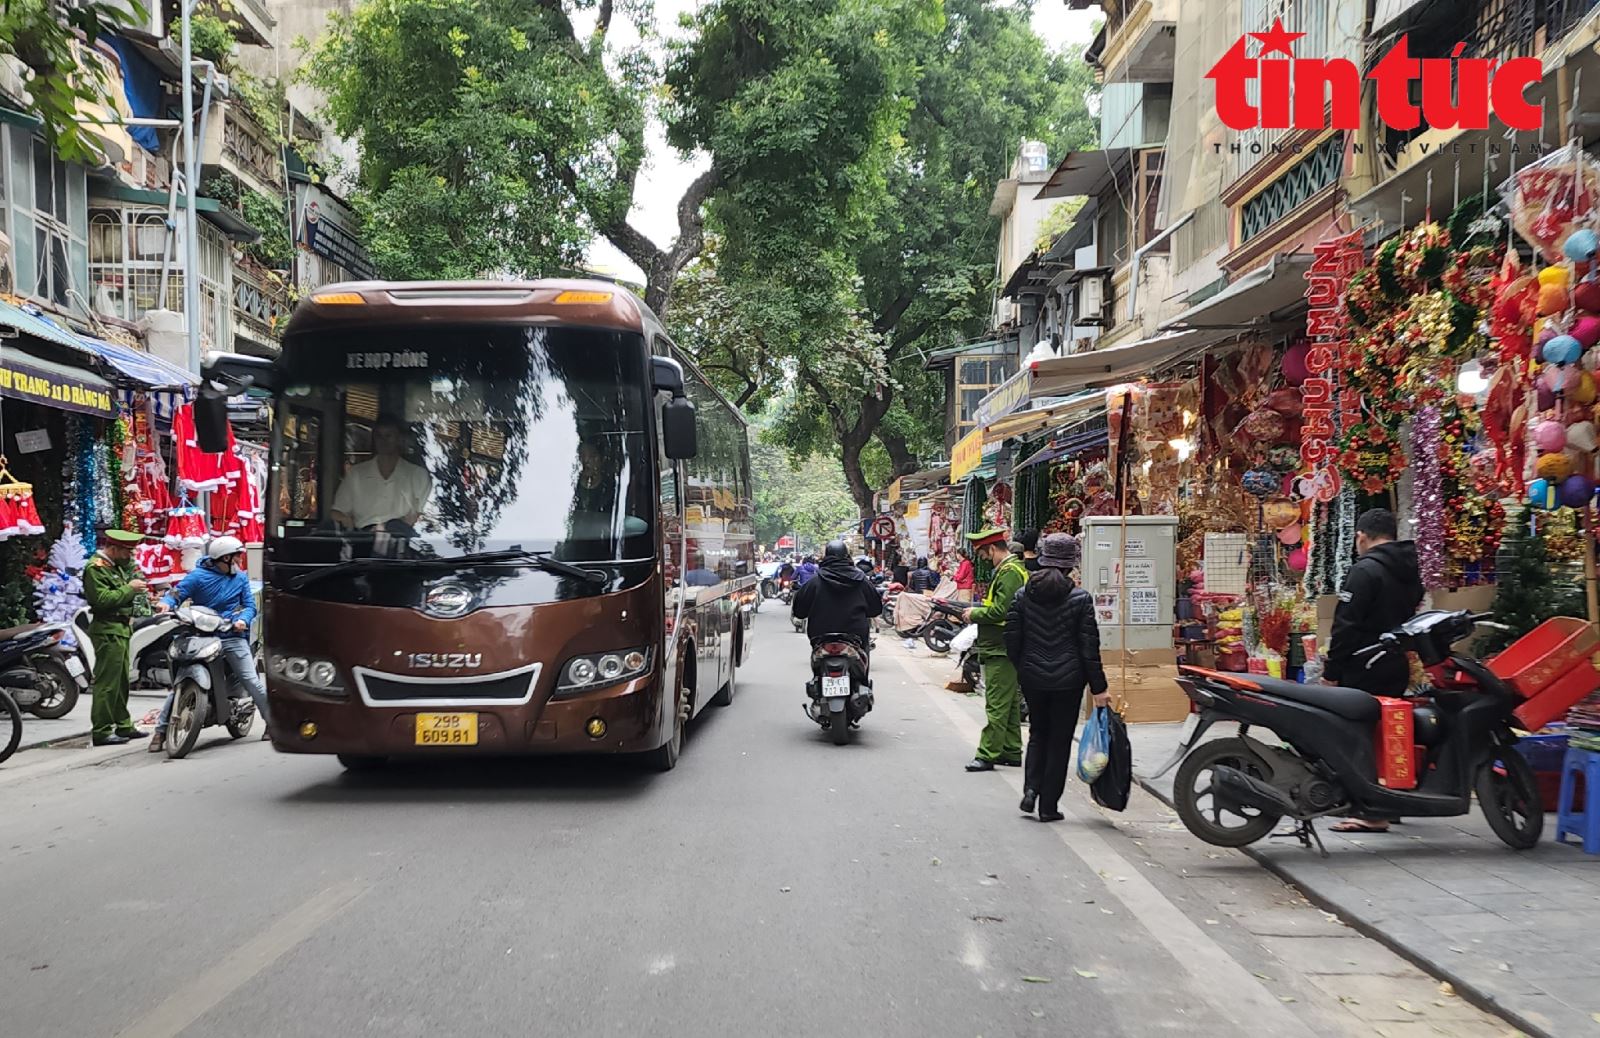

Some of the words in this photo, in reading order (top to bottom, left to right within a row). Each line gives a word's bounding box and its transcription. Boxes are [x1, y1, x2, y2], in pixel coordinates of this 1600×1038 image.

[13, 372, 50, 397] TRANG
[51, 384, 62, 401] 11
[62, 383, 71, 402] B
[71, 383, 98, 407] HÀNG
[408, 653, 482, 669] ISUZU
[433, 715, 461, 729] 29B
[422, 729, 470, 743] 609.81
